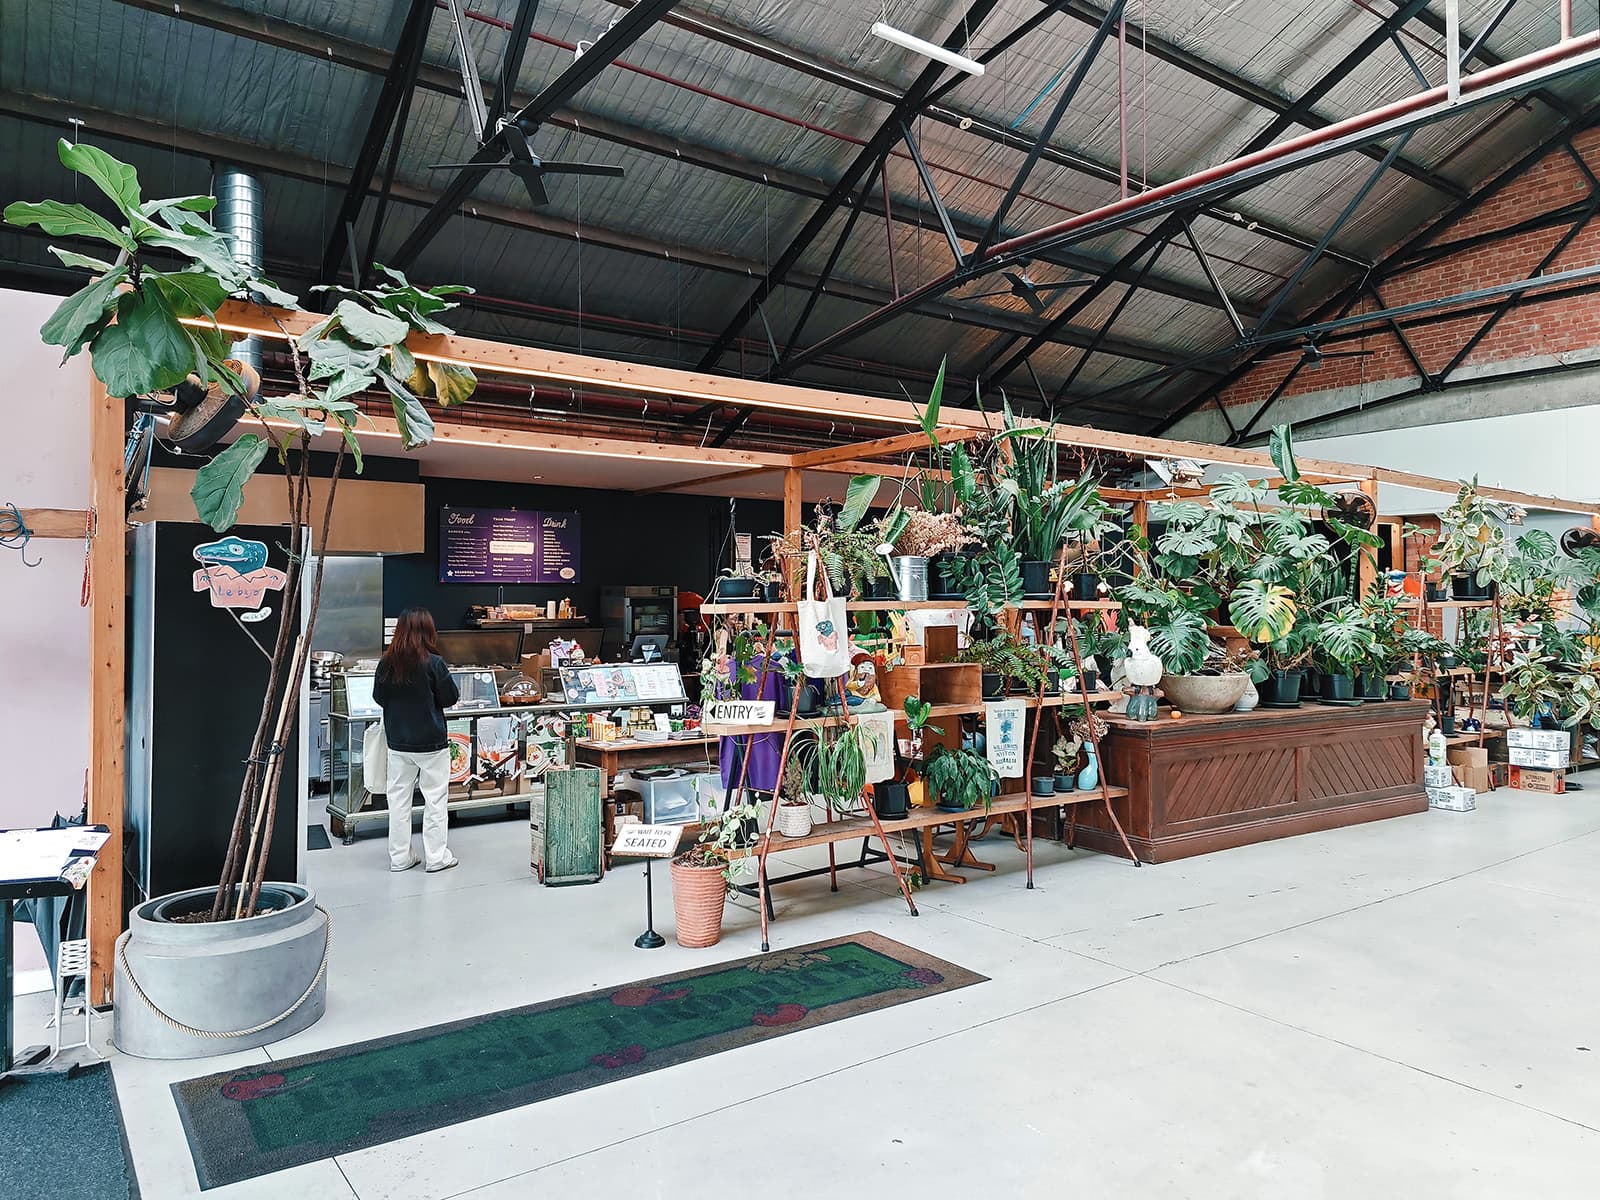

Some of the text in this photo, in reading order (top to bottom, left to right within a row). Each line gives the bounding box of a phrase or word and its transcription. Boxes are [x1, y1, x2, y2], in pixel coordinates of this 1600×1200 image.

[448, 513, 474, 525] Food
[542, 517, 567, 529] Drink
[717, 704, 754, 720] ENTRY
[624, 838, 667, 848] SEATED
